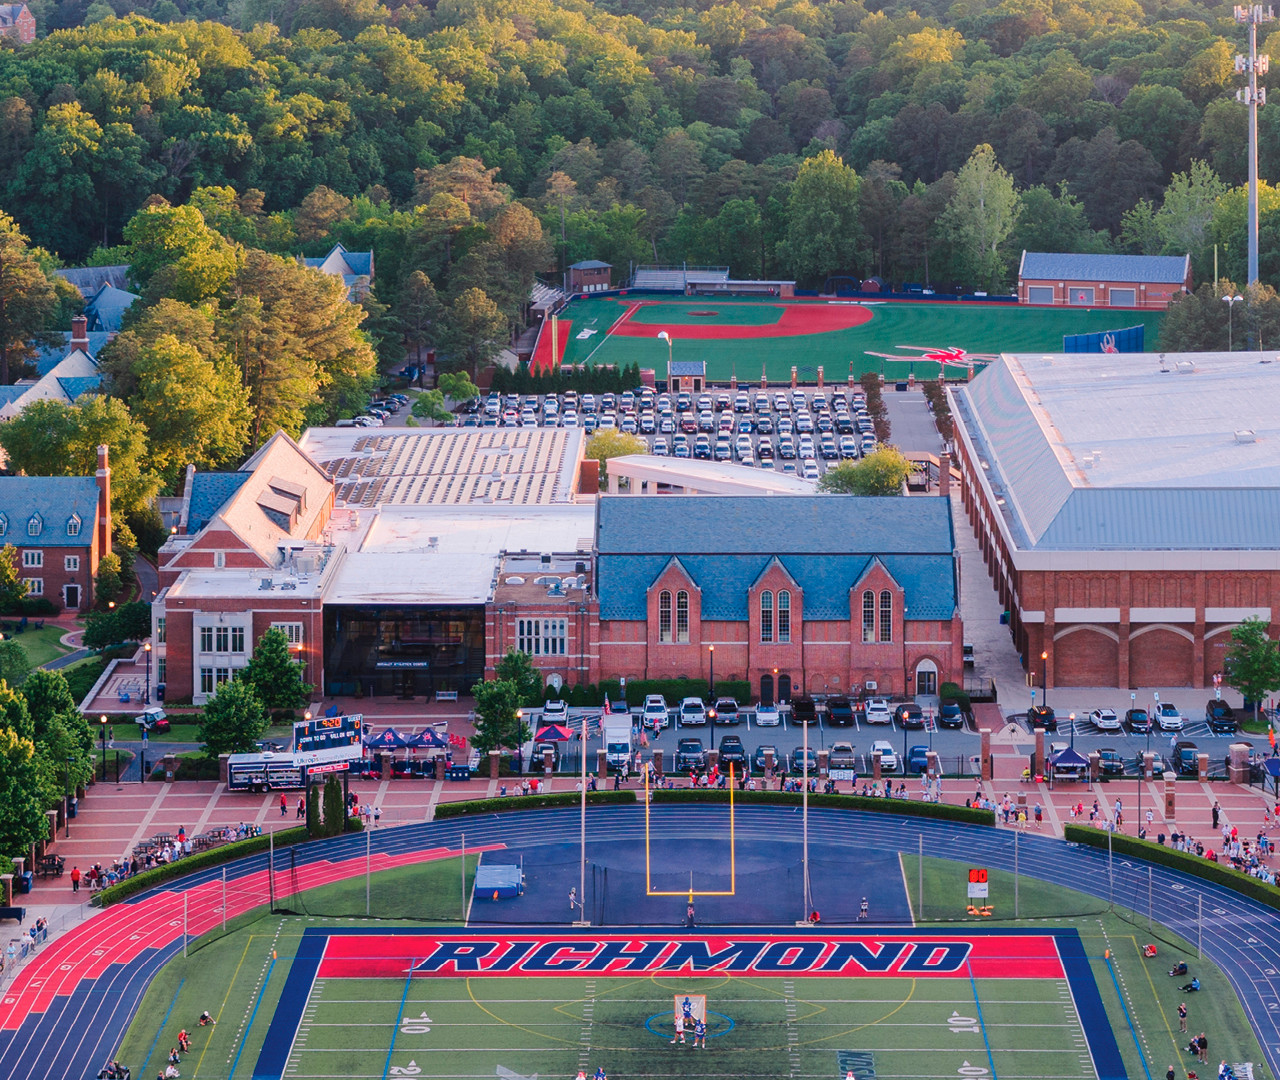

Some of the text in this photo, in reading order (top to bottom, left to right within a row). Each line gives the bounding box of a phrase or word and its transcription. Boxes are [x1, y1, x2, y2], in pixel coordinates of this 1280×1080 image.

[354, 720, 360, 729] 0
[402, 940, 973, 973] RICHMOND
[400, 1017, 433, 1034] 10
[946, 1016, 980, 1034] 10
[1275, 1046, 1280, 1054] 1
